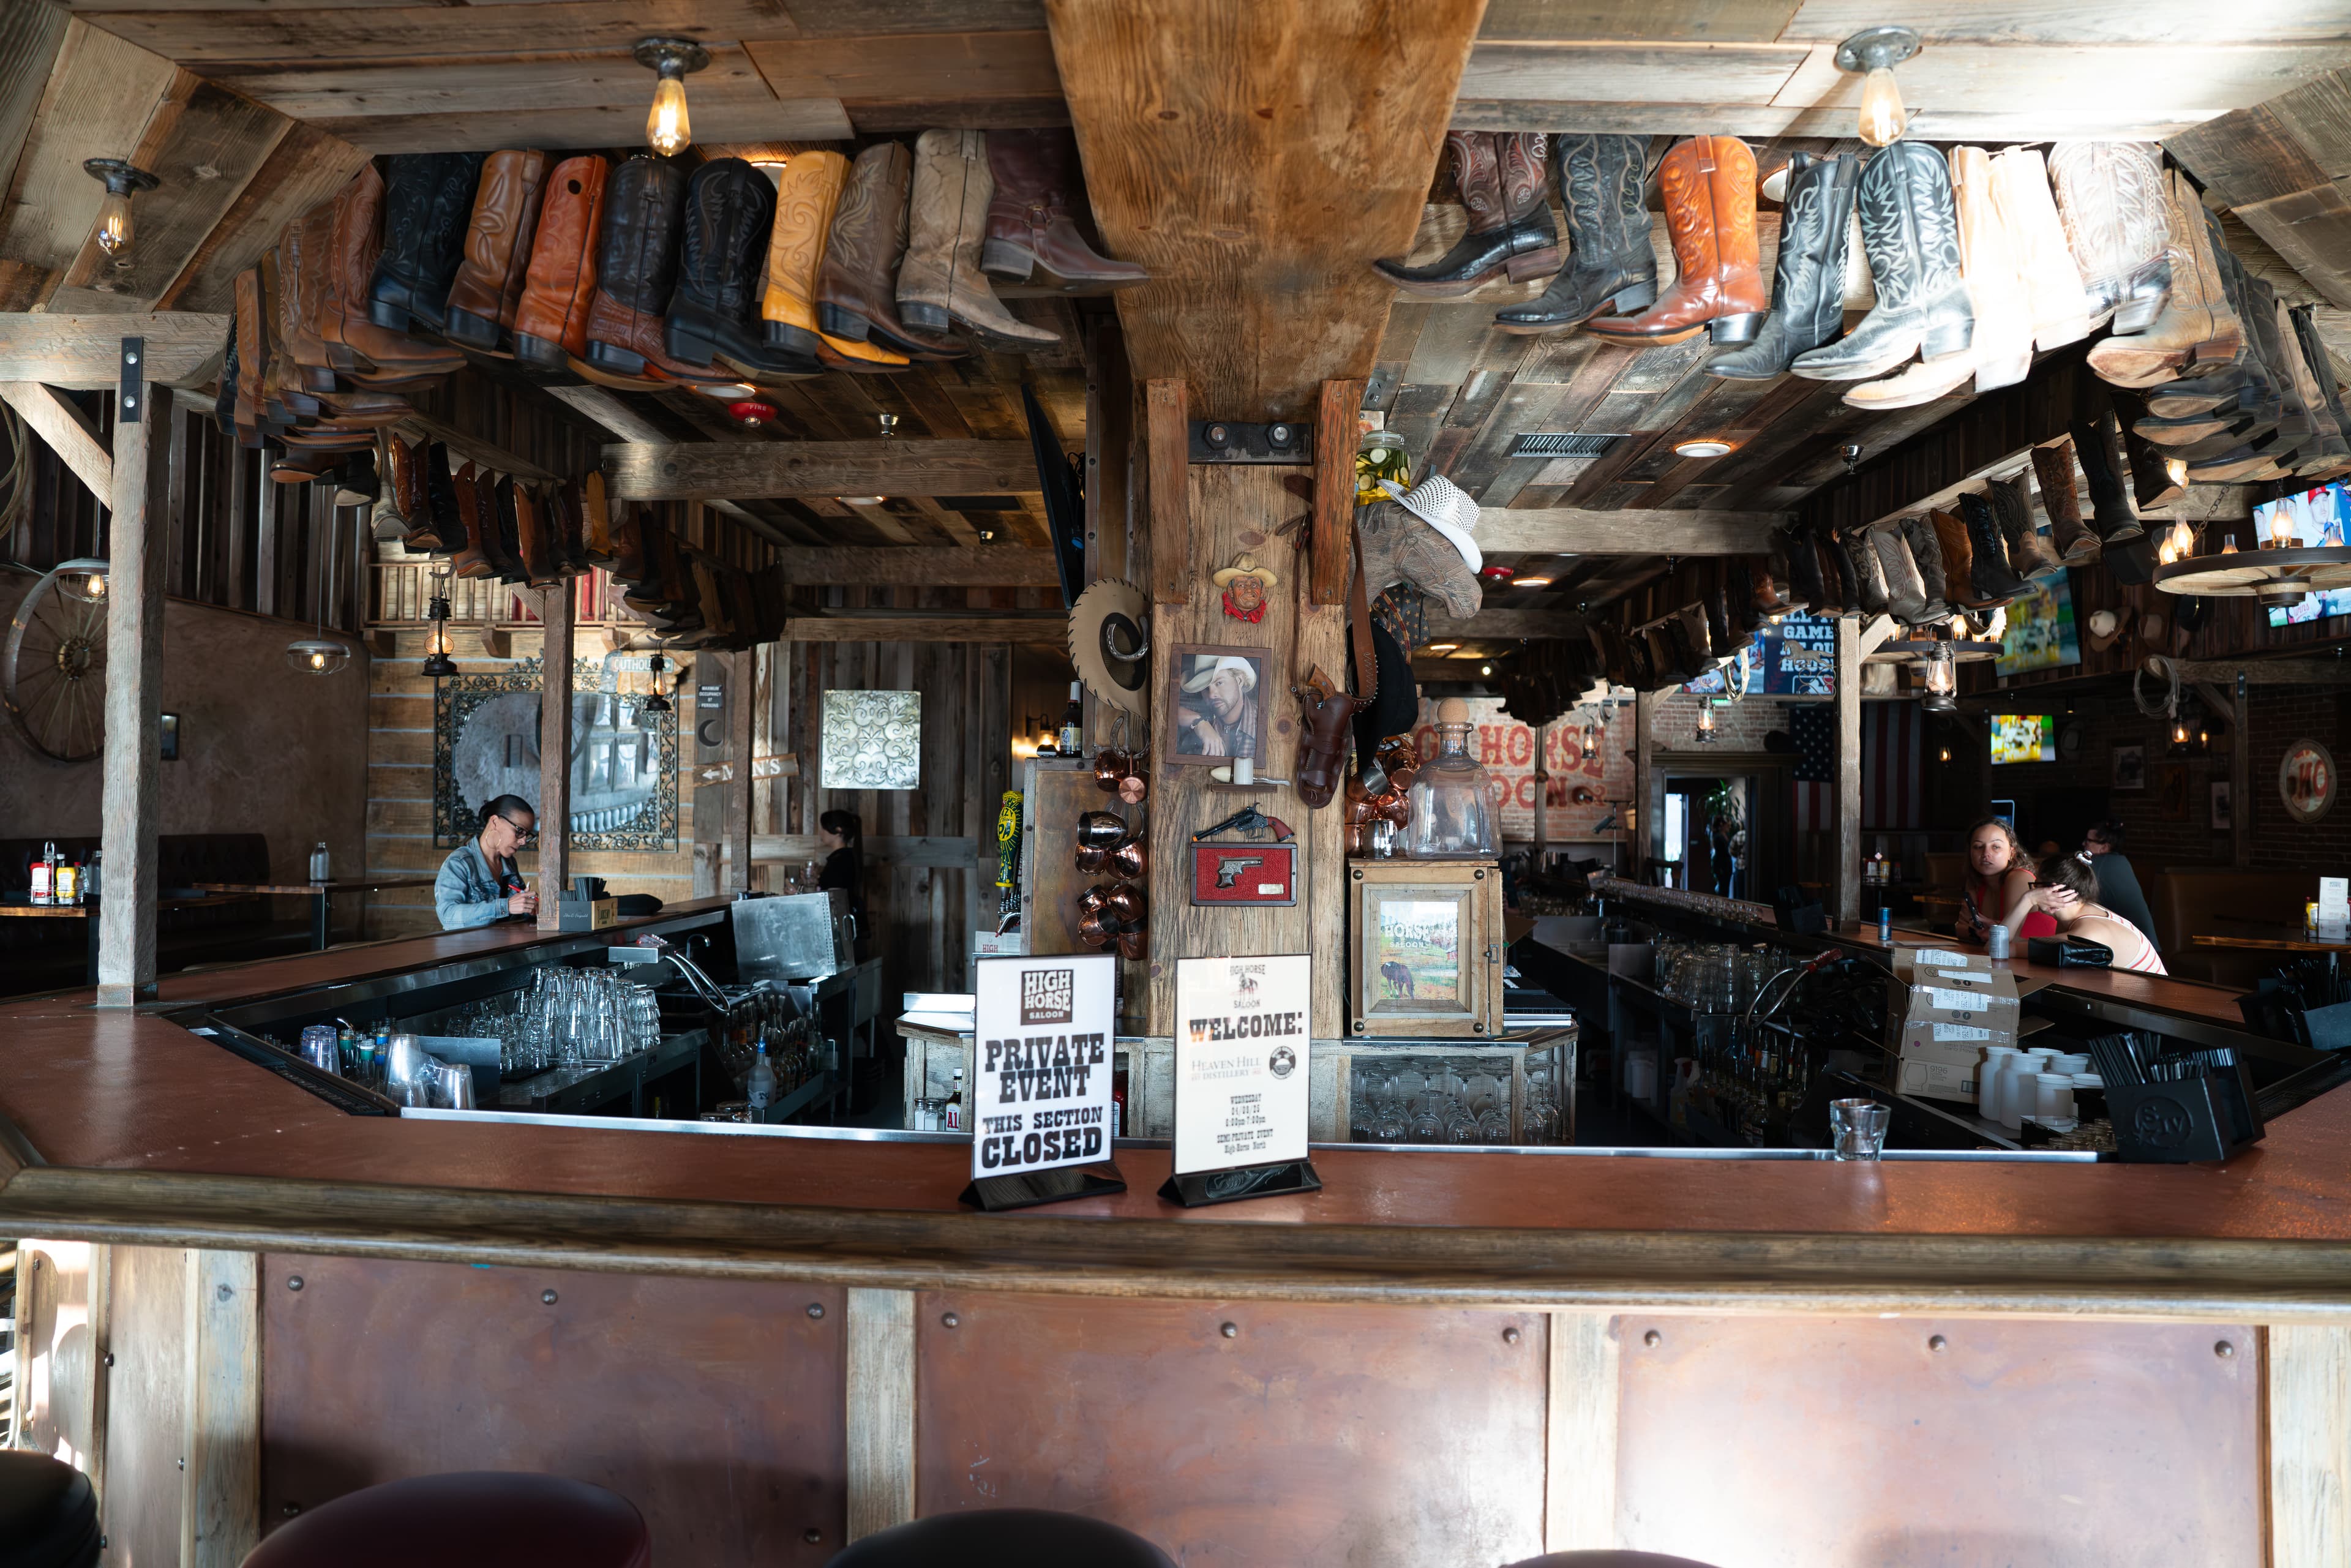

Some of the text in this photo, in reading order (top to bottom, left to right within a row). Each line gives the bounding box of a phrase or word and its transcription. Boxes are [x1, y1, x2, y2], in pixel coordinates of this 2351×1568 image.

[1479, 724, 1605, 779] HORSE
[721, 758, 781, 781] MN'S
[1384, 923, 1431, 943] HORSE
[982, 944, 999, 953] HIGH
[1245, 964, 1266, 975] HORSE
[1024, 970, 1071, 997] HIGH
[1024, 989, 1071, 1012] HORSE
[1234, 999, 1261, 1009] SALOON
[1029, 1010, 1064, 1019] SALOON
[1188, 1011, 1303, 1043] WELCOME:
[984, 1032, 1104, 1072] PRIVATE
[1191, 1056, 1261, 1071] HEAVEN HILL
[1930, 1065, 1948, 1074] 9196
[1202, 1069, 1249, 1080] DISTILLERY
[999, 1065, 1090, 1103] EVENT
[1230, 1093, 1262, 1105] WEDNESDAY
[947, 1111, 959, 1128] A1
[983, 1114, 1022, 1134] THIS
[1033, 1106, 1103, 1130] SECTION
[1256, 1128, 1273, 1139] EVENT
[981, 1127, 1102, 1169] CLOSED
